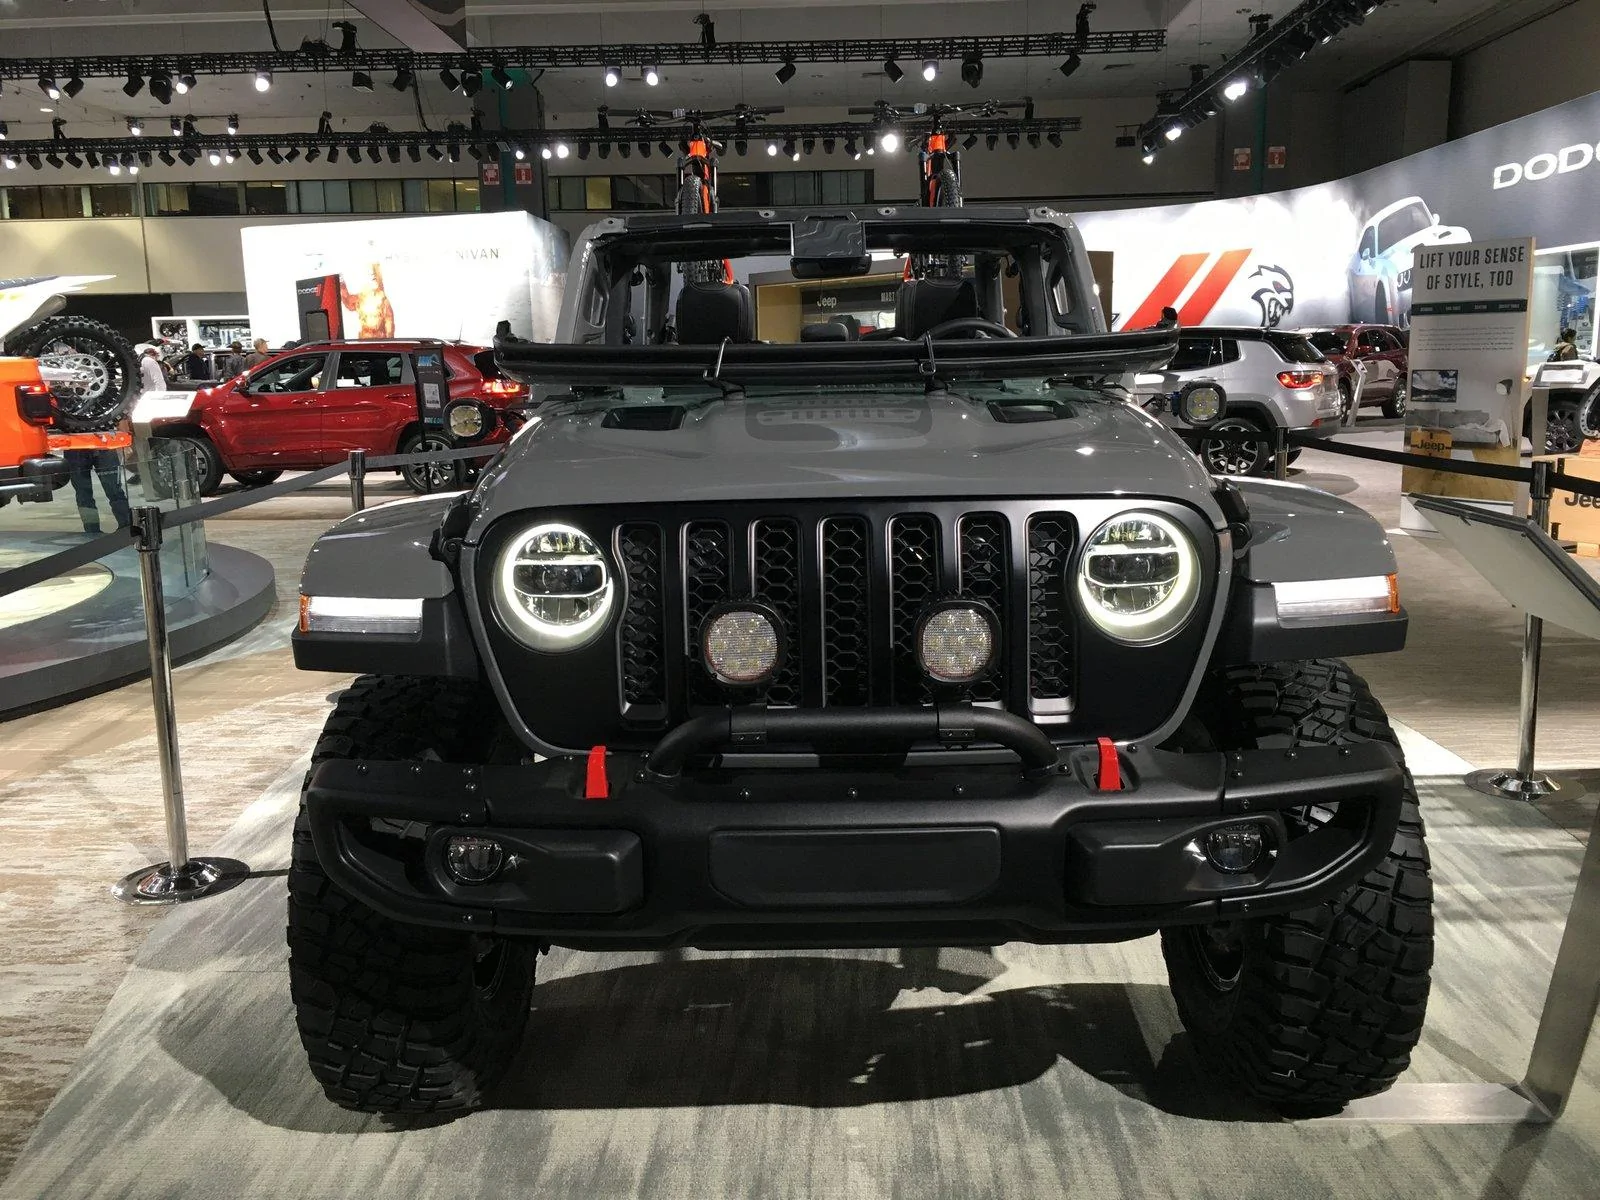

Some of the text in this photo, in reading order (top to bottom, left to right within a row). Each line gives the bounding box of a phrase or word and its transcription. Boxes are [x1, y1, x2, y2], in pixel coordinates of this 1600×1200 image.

[1492, 140, 1600, 190] DOD
[1419, 246, 1525, 269] LIFT YOUR SENSE
[1426, 269, 1514, 290] OF STYLE, TOO
[816, 291, 895, 308] Jeep MAST
[1416, 439, 1446, 451] Jeep
